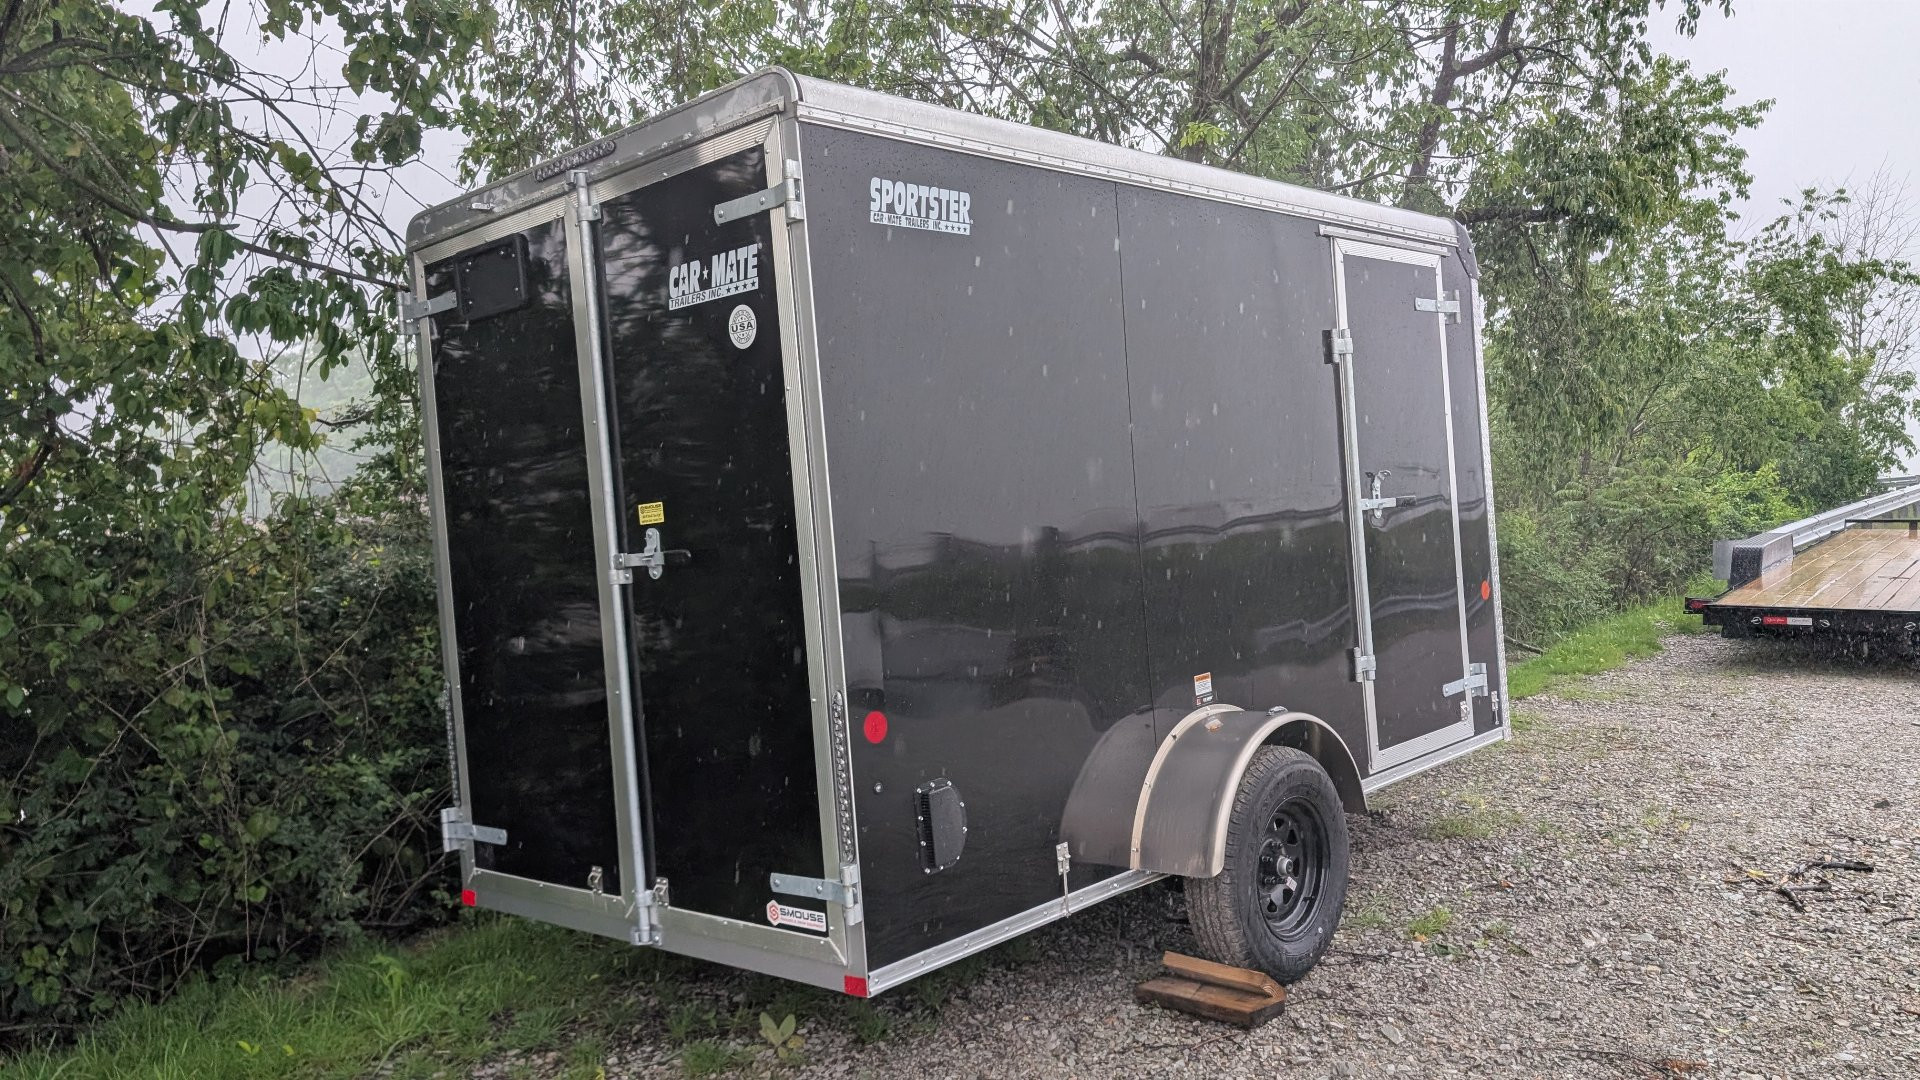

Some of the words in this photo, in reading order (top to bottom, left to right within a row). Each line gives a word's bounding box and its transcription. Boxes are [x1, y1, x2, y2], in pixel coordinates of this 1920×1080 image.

[870, 177, 971, 224] SPORTSTER
[887, 214, 902, 226] MATE
[905, 216, 930, 229] TRAILERS
[669, 260, 701, 299] CAR
[711, 243, 758, 289] MATE
[670, 291, 706, 309] TRAILERS
[708, 287, 724, 299] INC.
[731, 321, 754, 333] USA
[780, 907, 824, 923] SMOUSE
